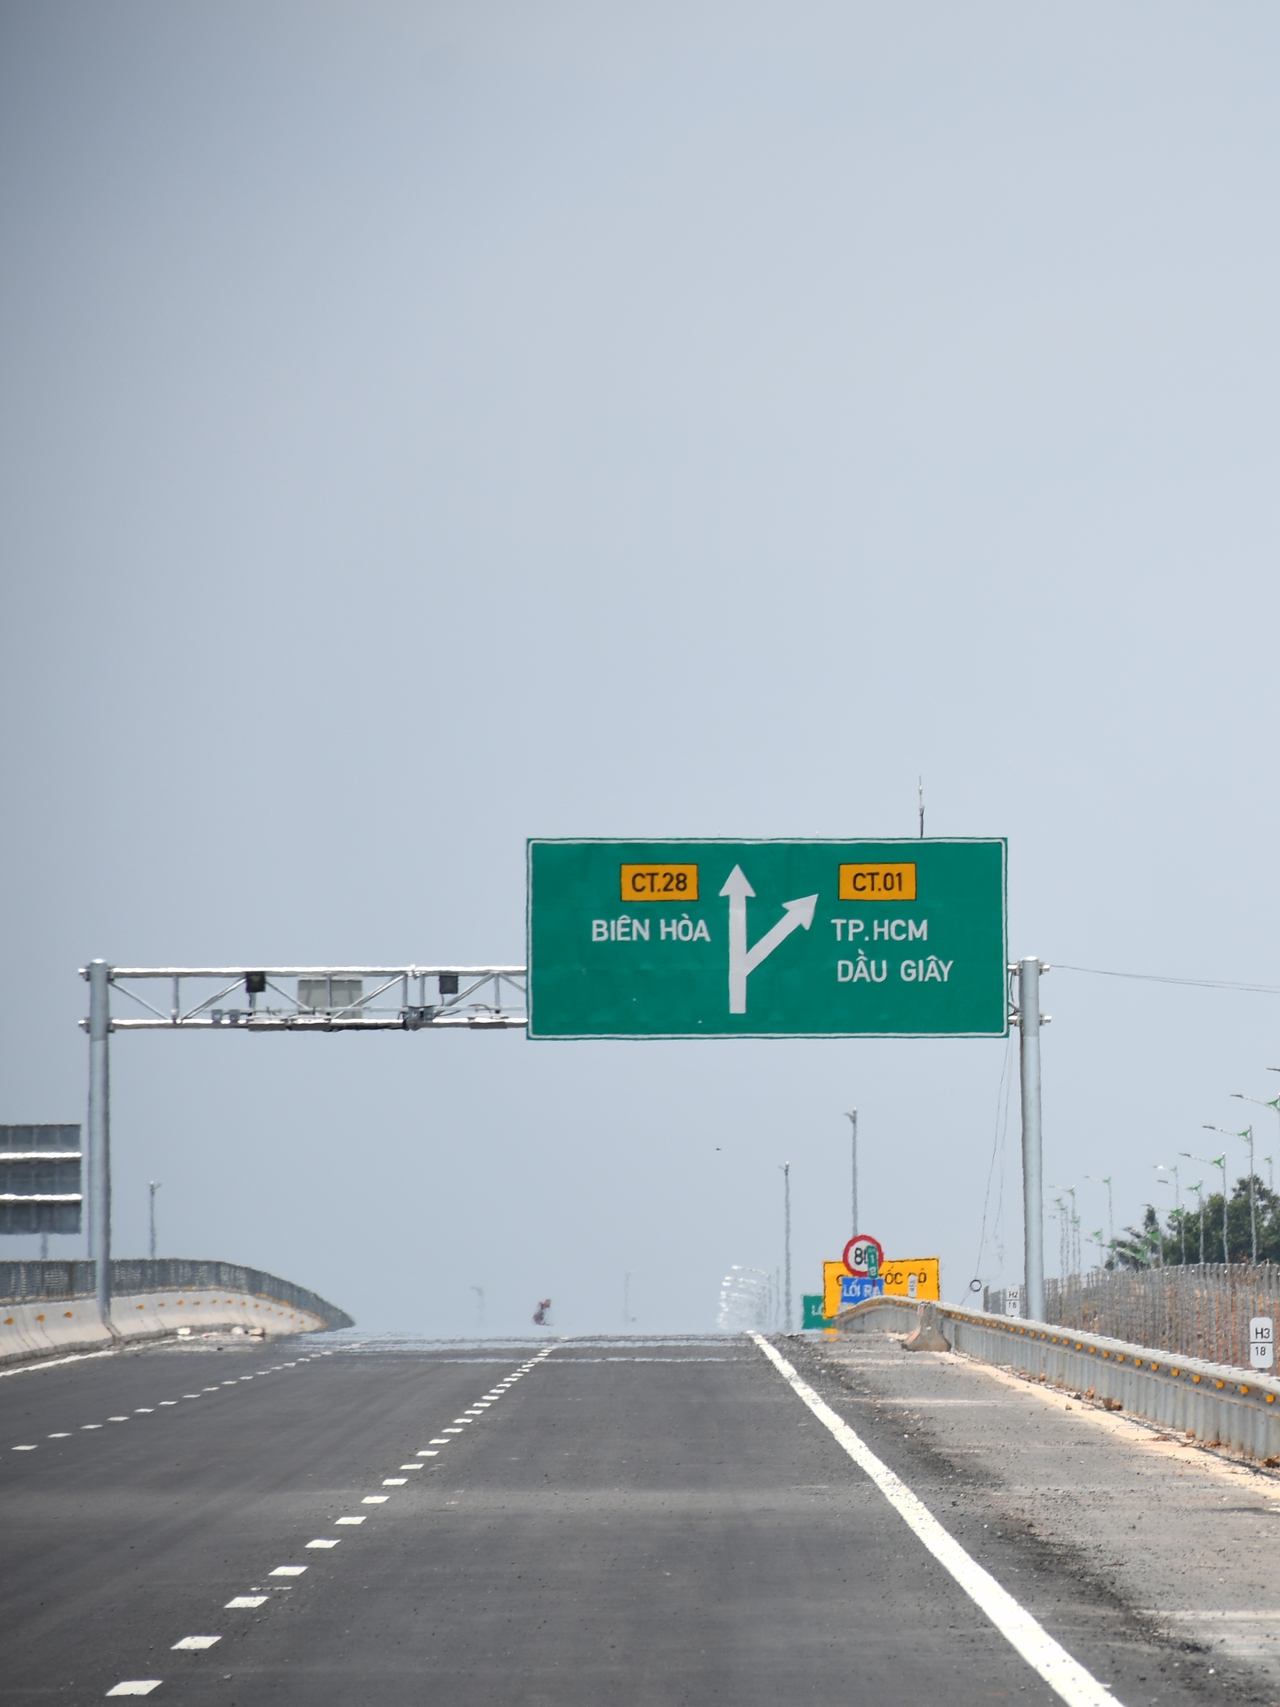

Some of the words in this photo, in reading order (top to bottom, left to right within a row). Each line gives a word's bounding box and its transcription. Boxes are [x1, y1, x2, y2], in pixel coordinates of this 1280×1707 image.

[631, 872, 688, 893] CT.28
[852, 872, 903, 892] CT.01
[591, 914, 650, 942] BIÊN
[659, 912, 712, 942] HÒA
[830, 918, 929, 942] TP.HCM
[837, 948, 888, 983] DẦU
[899, 954, 954, 982] GIÂY
[843, 1278, 861, 1298] LỐI
[863, 1284, 882, 1298] RA
[1255, 1327, 1271, 1340] H3
[1255, 1346, 1267, 1356] 18
